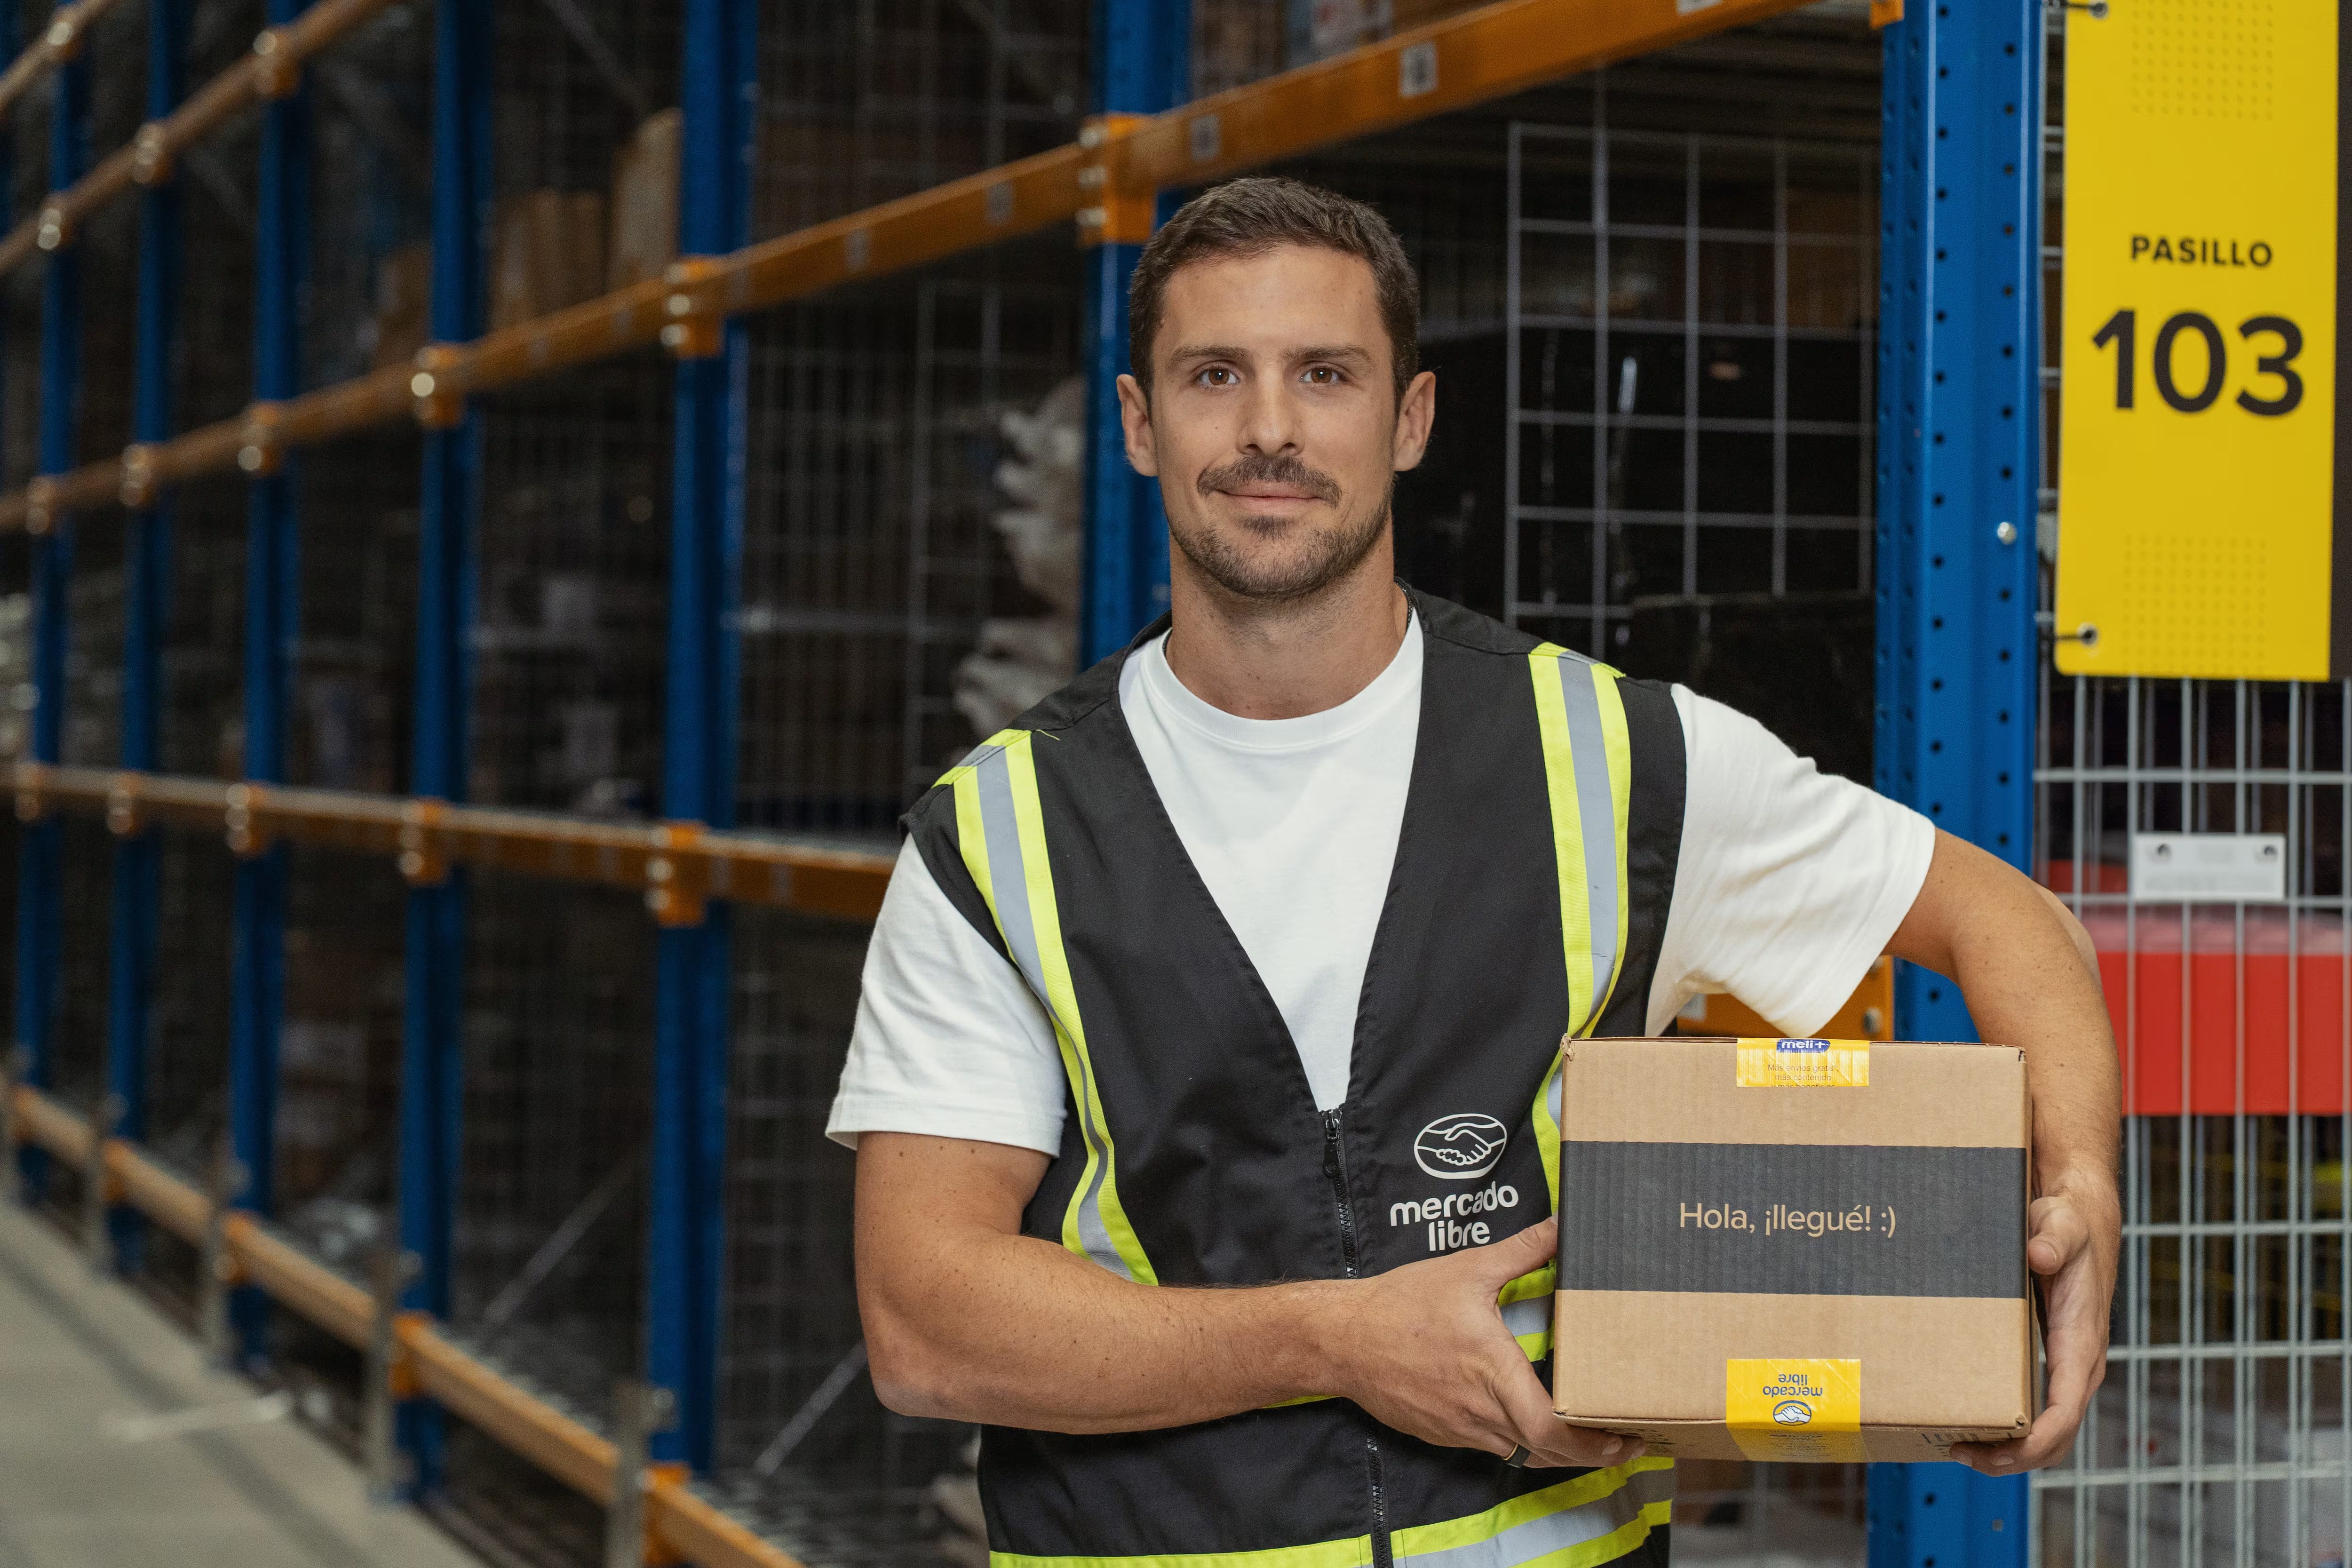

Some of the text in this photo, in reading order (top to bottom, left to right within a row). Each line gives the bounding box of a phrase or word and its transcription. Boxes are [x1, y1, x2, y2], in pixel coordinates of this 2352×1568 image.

[2130, 235, 2273, 269] PASILLO
[2091, 307, 2304, 417] 103
[1781, 1040, 1826, 1049] meli+
[1390, 1181, 1519, 1227] mercado
[1680, 1202, 1755, 1233] Hola,
[1765, 1204, 1871, 1238] ¡llegué!
[1428, 1220, 1490, 1251] libre
[1763, 1385, 1823, 1398] mercado
[1778, 1374, 1808, 1386] libre
